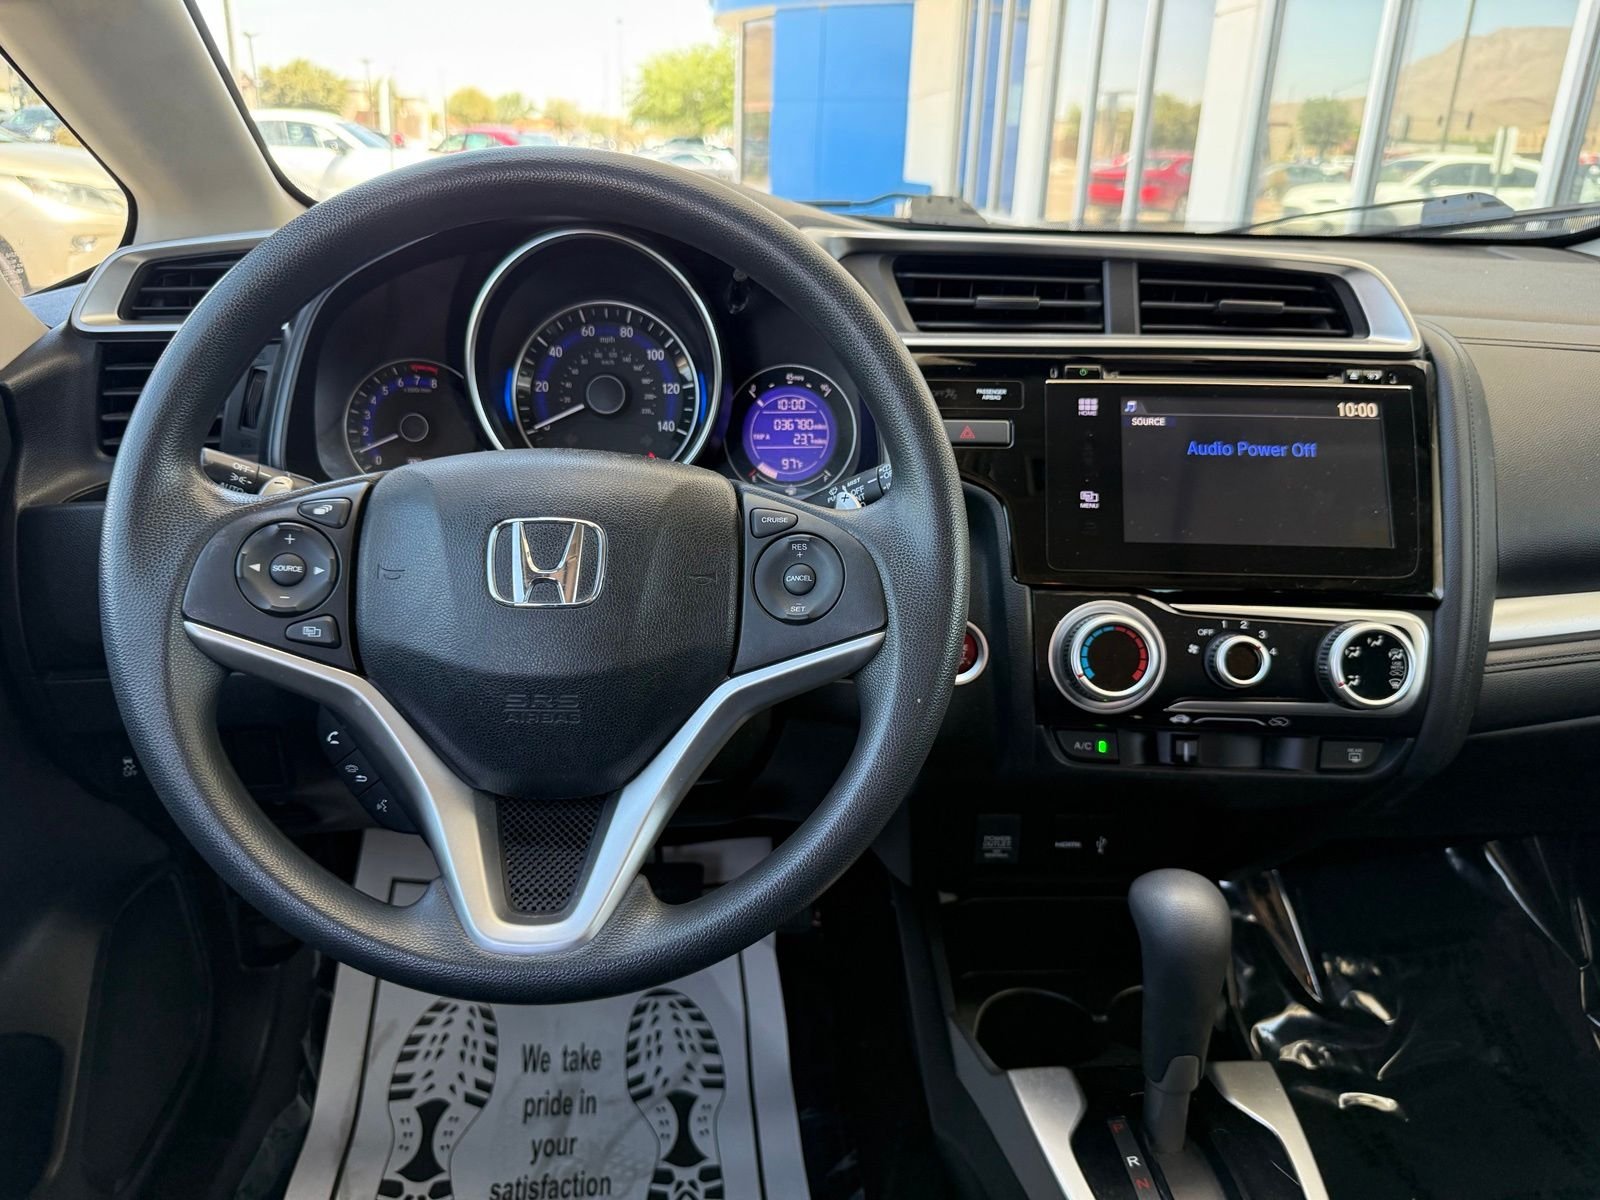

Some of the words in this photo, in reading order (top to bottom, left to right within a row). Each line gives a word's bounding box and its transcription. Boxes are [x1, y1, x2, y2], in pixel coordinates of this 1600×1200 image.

[581, 326, 595, 337] 60
[620, 327, 634, 338] 80
[600, 336, 615, 344] mph
[549, 346, 563, 358] 40
[647, 350, 665, 361] 100
[398, 379, 404, 388] 6
[414, 376, 421, 385] 7
[431, 379, 438, 389] 8
[382, 386, 389, 396] 5
[535, 381, 549, 393] 20
[662, 383, 681, 395] 120
[370, 396, 377, 405] 4
[777, 399, 806, 411] 10:00
[1337, 402, 1379, 418] 10:00
[364, 411, 371, 421] 3
[1131, 416, 1167, 427] SOURCE
[657, 420, 676, 432] 140
[774, 419, 814, 430] 036780
[362, 426, 369, 436] 2
[1186, 440, 1234, 457] Audio
[1237, 441, 1288, 458] Power
[1291, 442, 1317, 458] Off
[375, 455, 383, 466] 0
[233, 462, 250, 473] OFF
[850, 485, 865, 496] OFF
[761, 516, 788, 524] CRUISE
[791, 543, 808, 551] RES
[272, 564, 303, 573] SOURCE
[785, 575, 813, 583] CANCEL
[1221, 620, 1228, 629] 1
[1239, 620, 1249, 630] 2
[1197, 628, 1214, 637] OFF
[1258, 629, 1267, 640] 3
[1268, 646, 1278, 656] 4
[1073, 741, 1093, 751] A/C
[523, 1043, 550, 1072] We
[563, 1042, 602, 1072] take
[523, 1089, 573, 1124] pride
[579, 1088, 597, 1115] in
[530, 1136, 578, 1165] your
[1126, 1155, 1141, 1168] R
[489, 1170, 611, 1200] satisfaction
[1135, 1177, 1151, 1190] N
